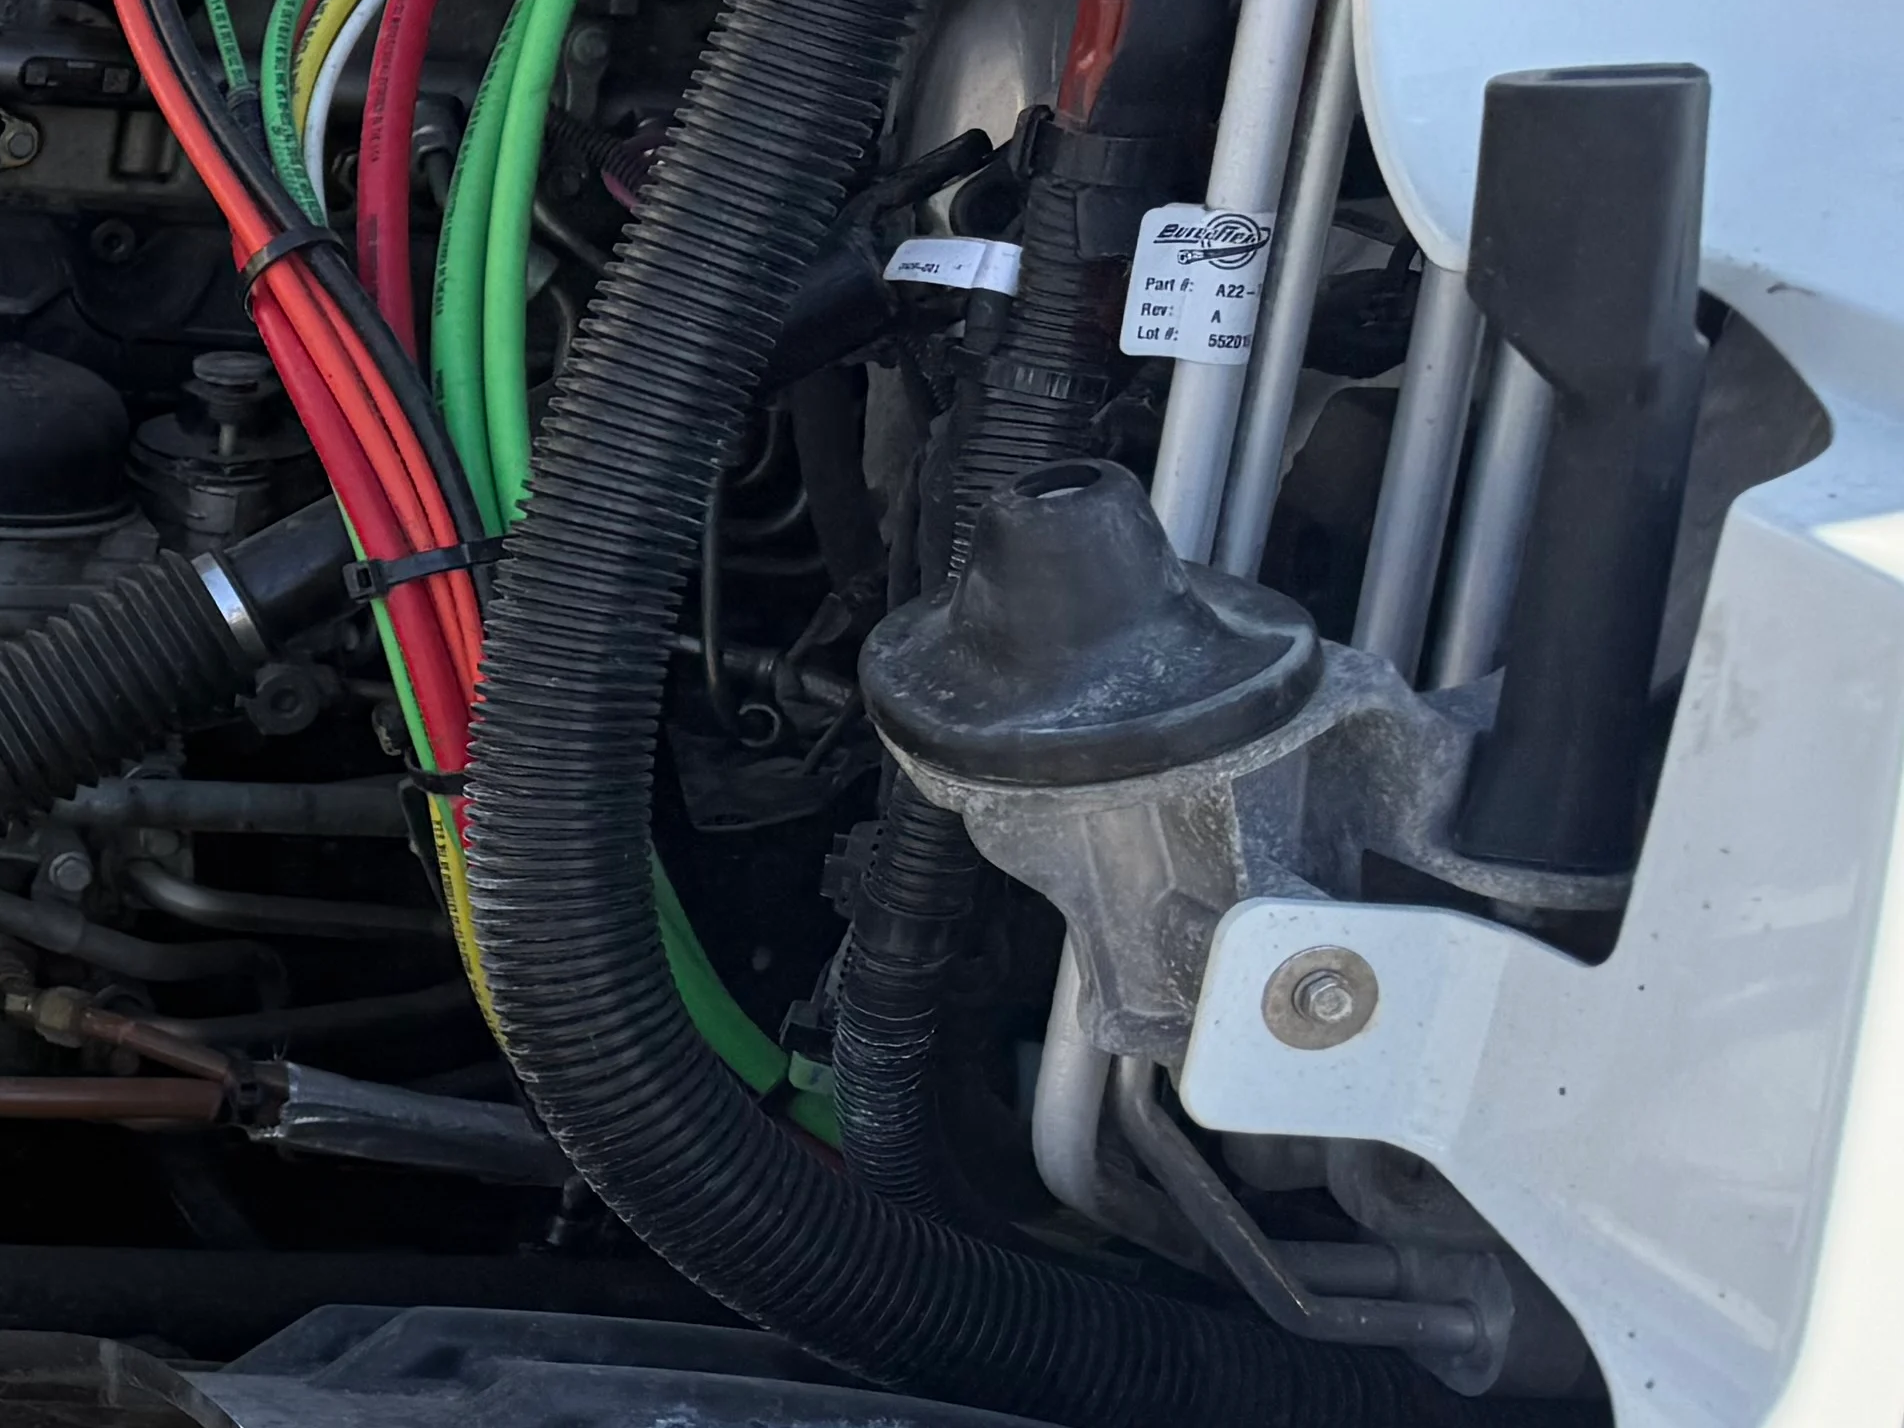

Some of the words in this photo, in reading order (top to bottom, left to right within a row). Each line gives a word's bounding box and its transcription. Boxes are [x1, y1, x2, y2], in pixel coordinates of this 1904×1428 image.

[1145, 277, 1175, 291] Part
[1180, 277, 1195, 292] #:
[1141, 302, 1175, 317] Rev:
[1210, 309, 1222, 324] A
[1137, 325, 1160, 340] Lot
[1164, 327, 1179, 341] #:
